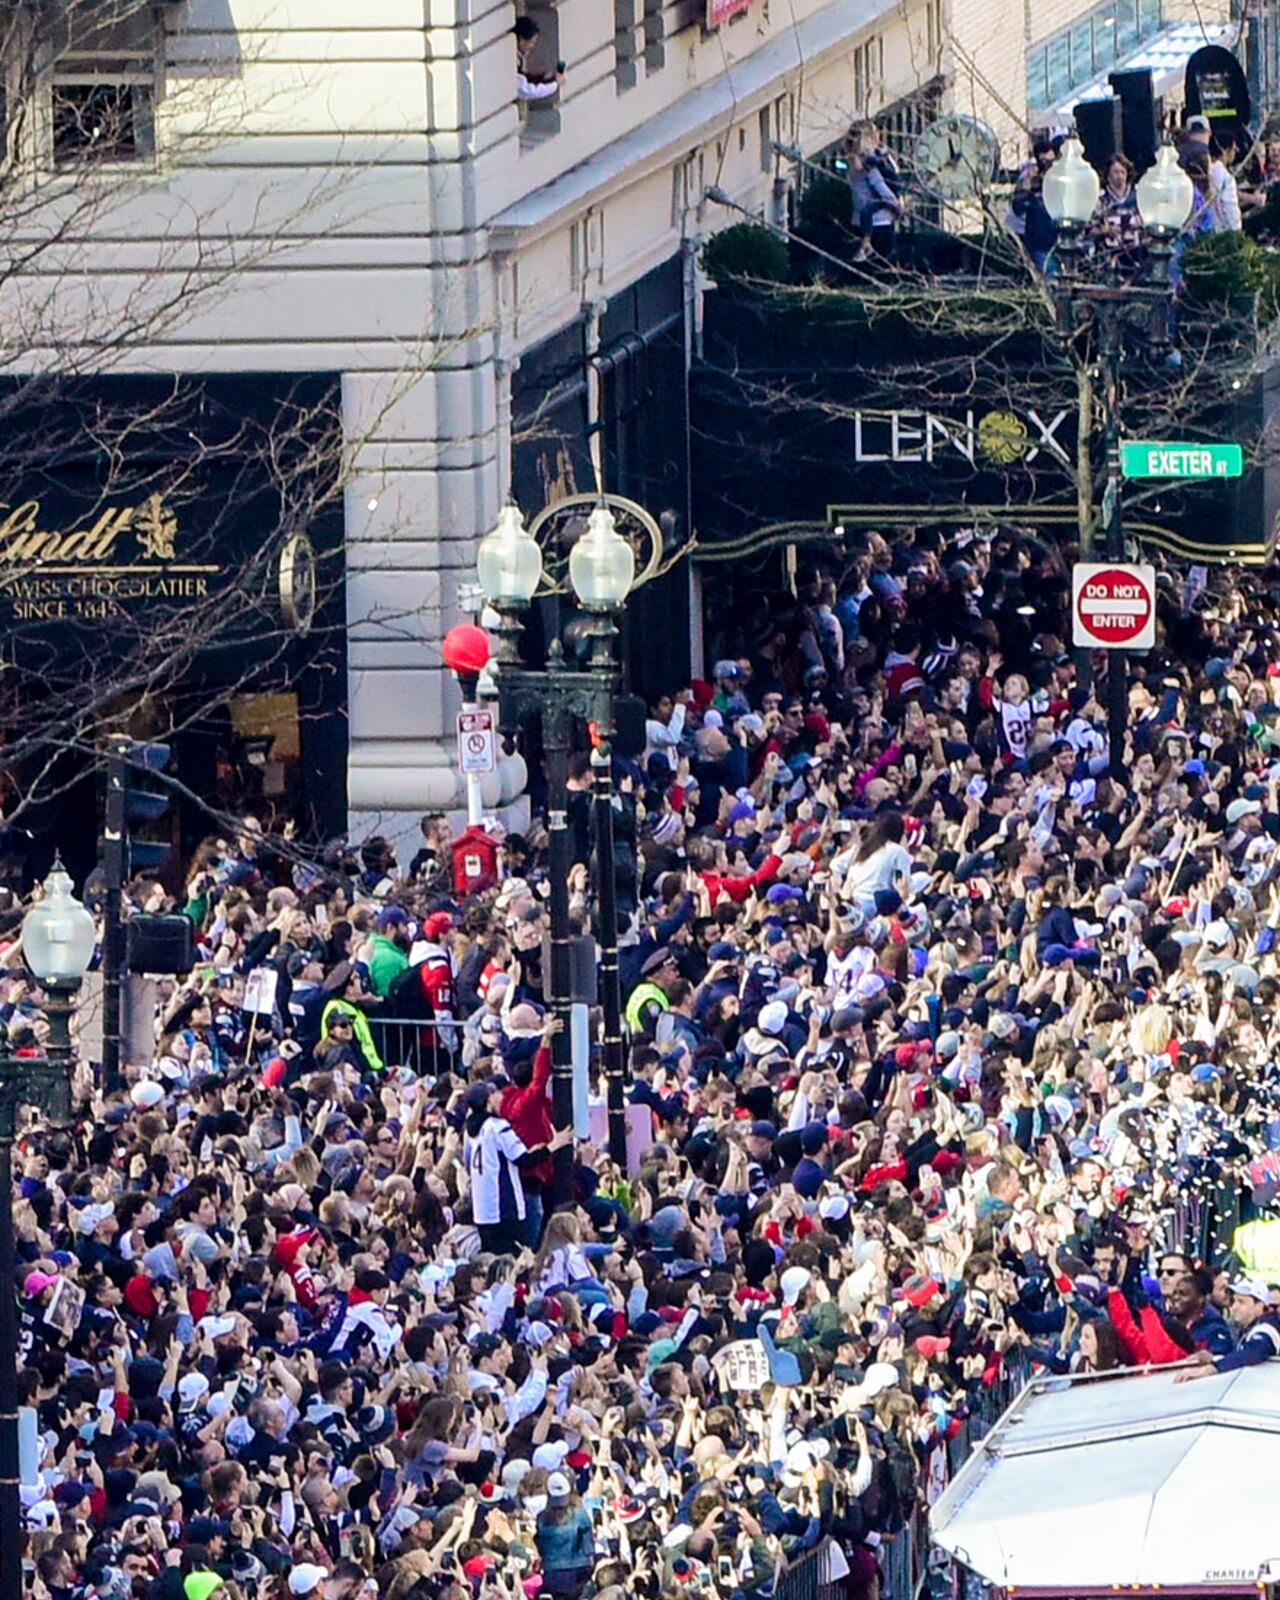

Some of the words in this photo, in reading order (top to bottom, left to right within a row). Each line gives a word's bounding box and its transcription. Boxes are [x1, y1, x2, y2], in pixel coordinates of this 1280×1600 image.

[1148, 451, 1212, 475] EXETER
[1216, 461, 1228, 475] ST
[68, 578, 208, 598] CHOCOLATIER
[1086, 584, 1107, 598] DO
[1113, 584, 1141, 598] NOT
[13, 601, 68, 618] SINCE
[1092, 615, 1136, 628] ENTER
